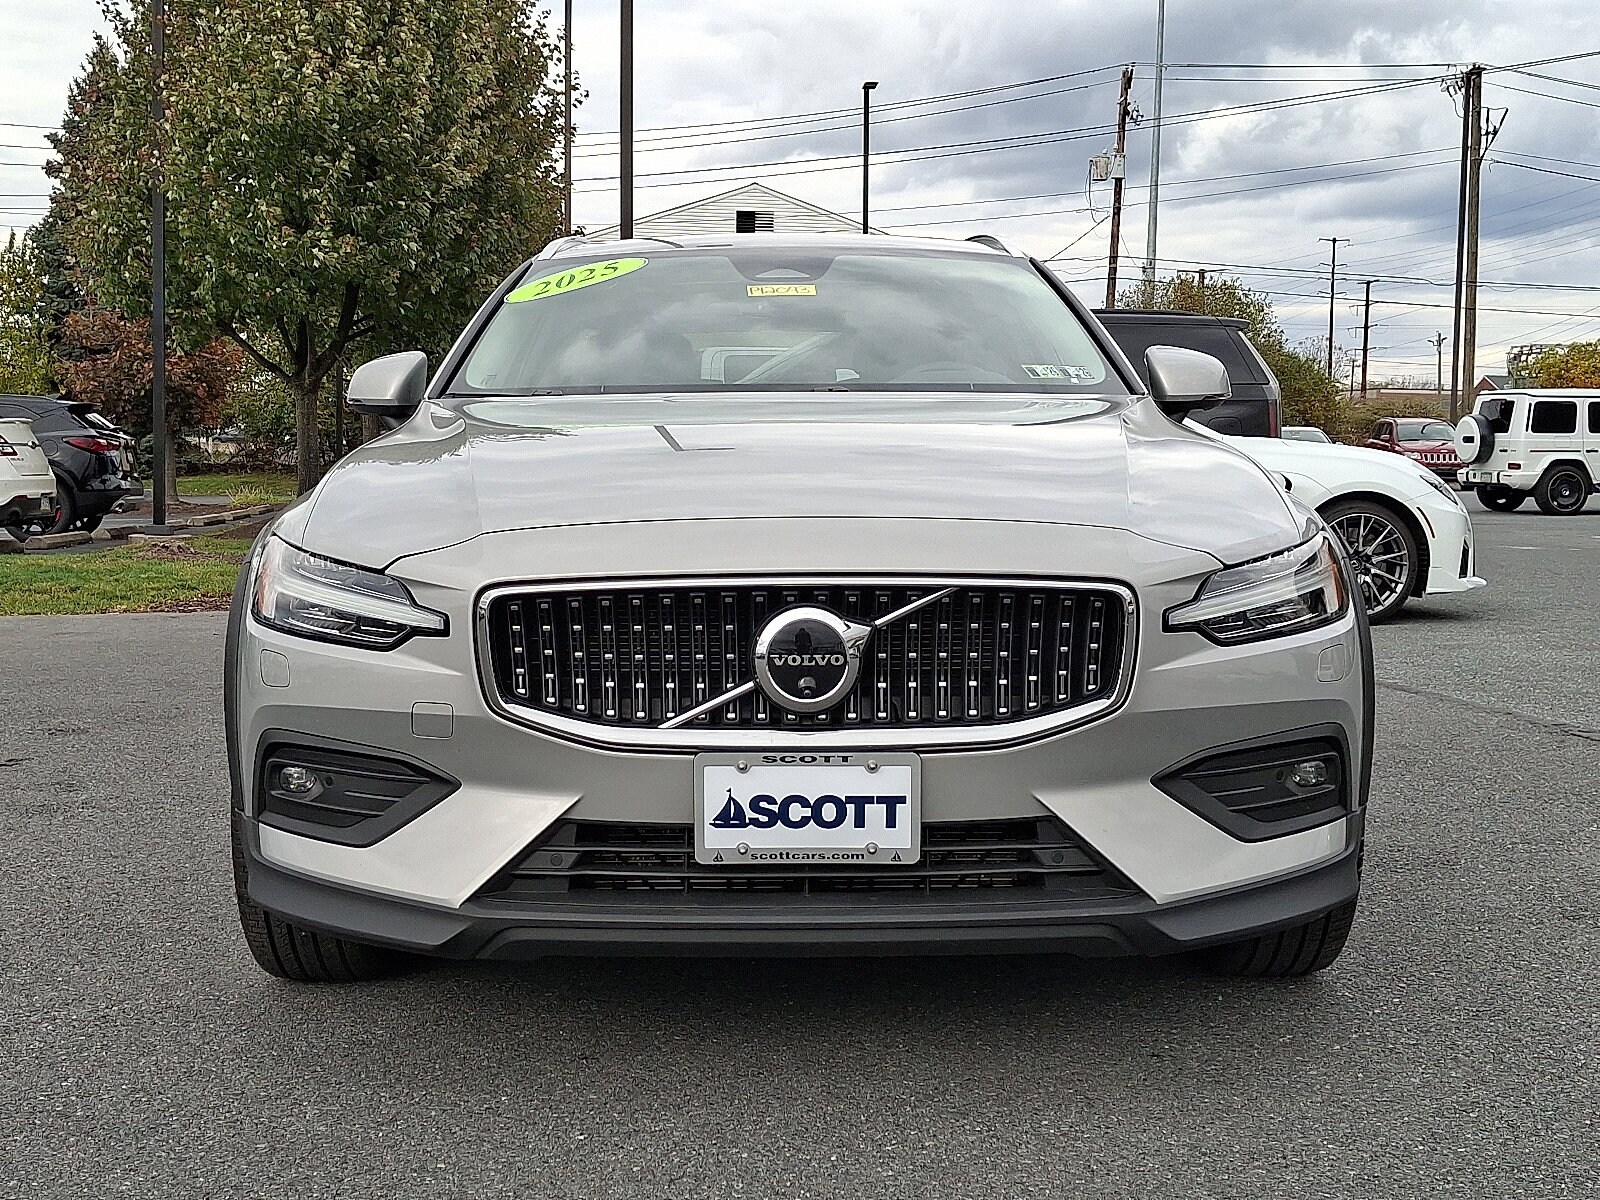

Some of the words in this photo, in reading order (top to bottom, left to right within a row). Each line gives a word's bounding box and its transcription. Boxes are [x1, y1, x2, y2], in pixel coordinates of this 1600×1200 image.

[532, 261, 620, 298] 2025
[769, 654, 845, 666] VOLVO
[761, 755, 854, 764] SCOTT
[747, 794, 907, 830] SCOTT
[750, 851, 866, 861] scottcars.com
